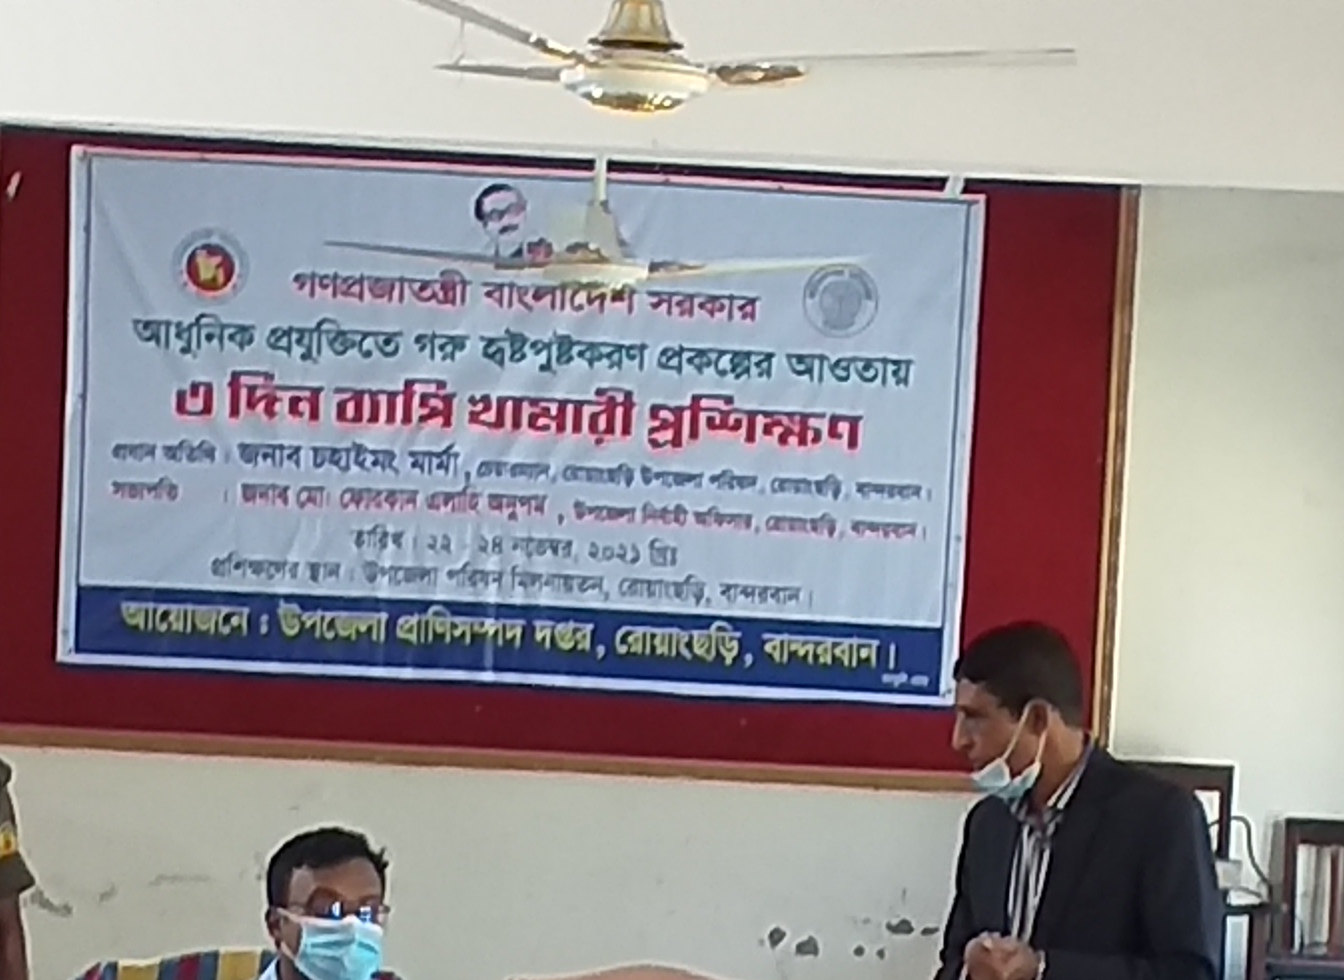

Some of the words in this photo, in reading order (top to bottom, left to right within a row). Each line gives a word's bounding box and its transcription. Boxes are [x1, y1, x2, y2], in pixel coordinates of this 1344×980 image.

[483, 281, 636, 315] বাংলাদেশ
[646, 289, 760, 322] সরকার
[133, 313, 256, 358] আধুনিক
[266, 317, 403, 364] প্রযুক্তিতে
[414, 329, 470, 362] গরু
[657, 343, 775, 381] প্রকল্পের
[786, 352, 914, 388] আওতায়
[175, 379, 214, 416] ৩
[228, 369, 323, 423] দিন
[467, 387, 636, 445] খামারী
[647, 393, 864, 452] প্রশিক্ষণ
[237, 442, 303, 468] জনাব
[587, 541, 641, 563] ২০২১
[120, 601, 251, 639] আয়োজনে
[276, 599, 389, 644] উপজেলা
[396, 605, 525, 651] প্রাণিসম্পদ
